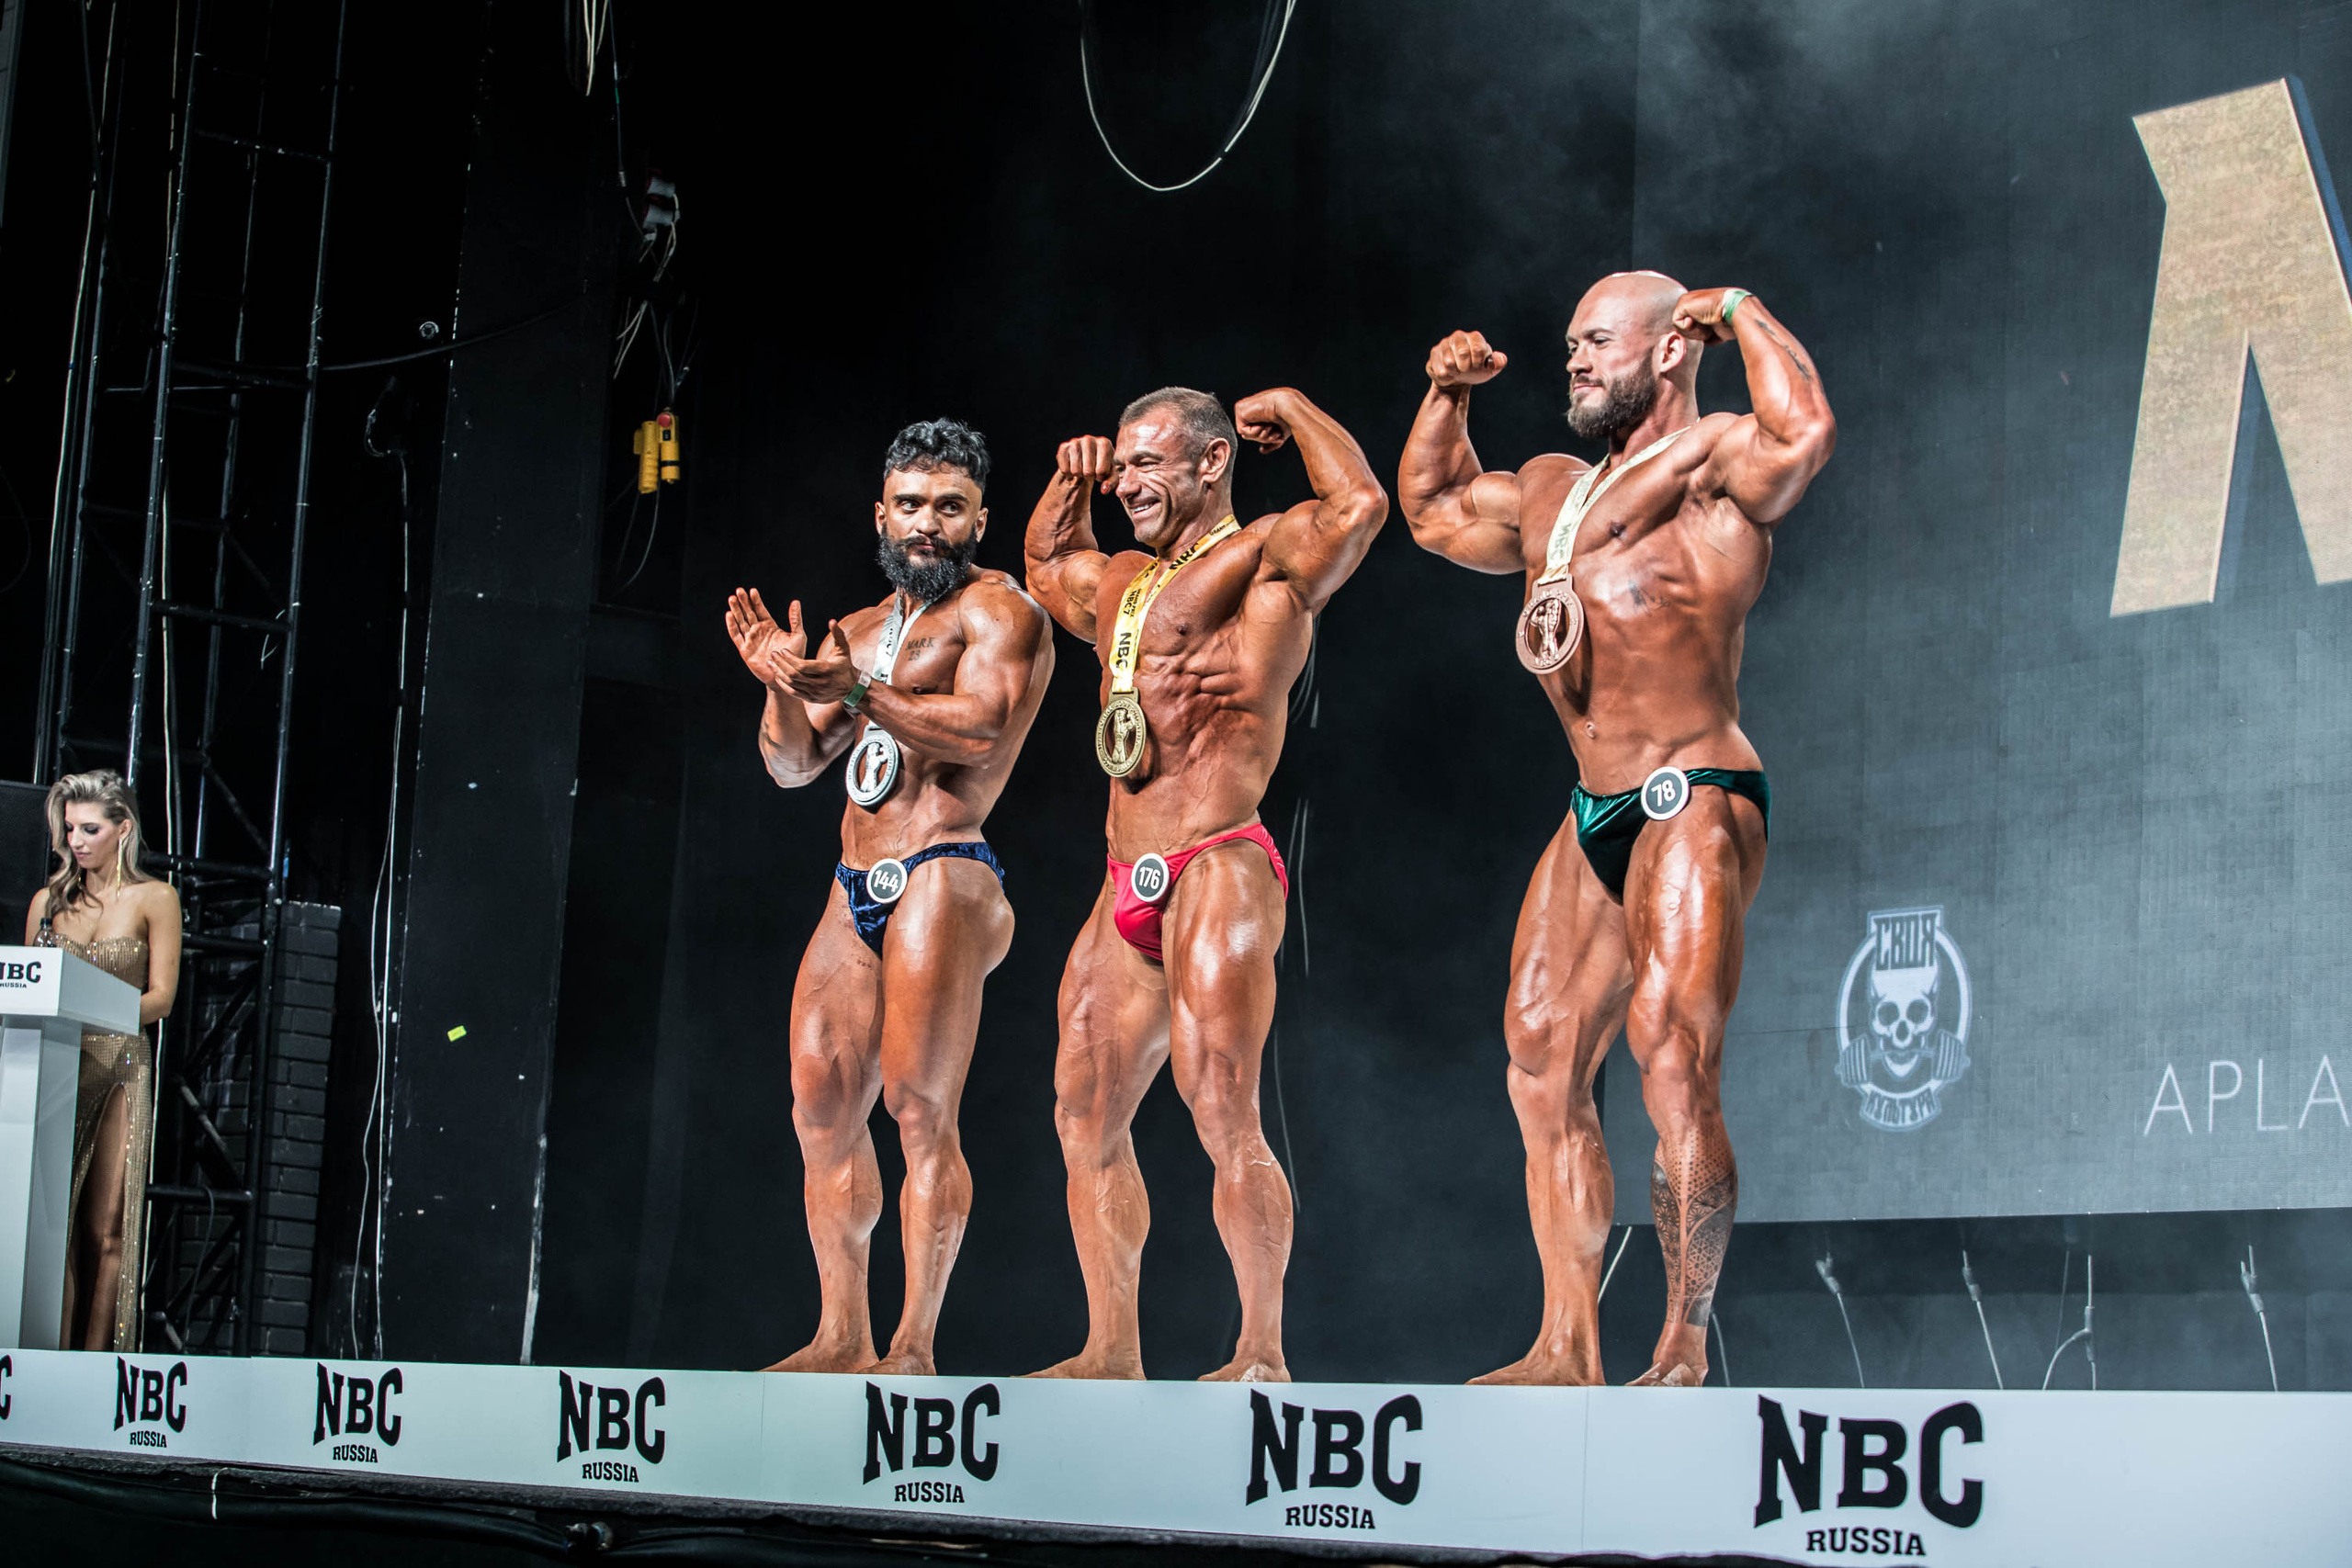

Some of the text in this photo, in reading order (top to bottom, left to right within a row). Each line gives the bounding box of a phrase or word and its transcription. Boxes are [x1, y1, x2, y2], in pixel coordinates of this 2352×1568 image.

[1115, 632, 1132, 669] NBC
[1651, 779, 1676, 807] 78
[874, 869, 899, 893] 144
[1139, 866, 1161, 890] 176
[114, 1356, 187, 1432] NBC
[313, 1362, 402, 1447] NBC
[557, 1370, 666, 1465] NBC
[130, 1430, 167, 1448] RUSSIA
[862, 1381, 1001, 1485] NBC
[1245, 1388, 1422, 1506] NBC
[333, 1444, 379, 1462] RUSSIA
[1754, 1394, 1984, 1529] NBC
[582, 1461, 639, 1483] RUSSIA
[894, 1481, 966, 1504] RUSSIA
[1285, 1504, 1375, 1529] RUSSIA
[1806, 1527, 1926, 1556] RUSSIA
